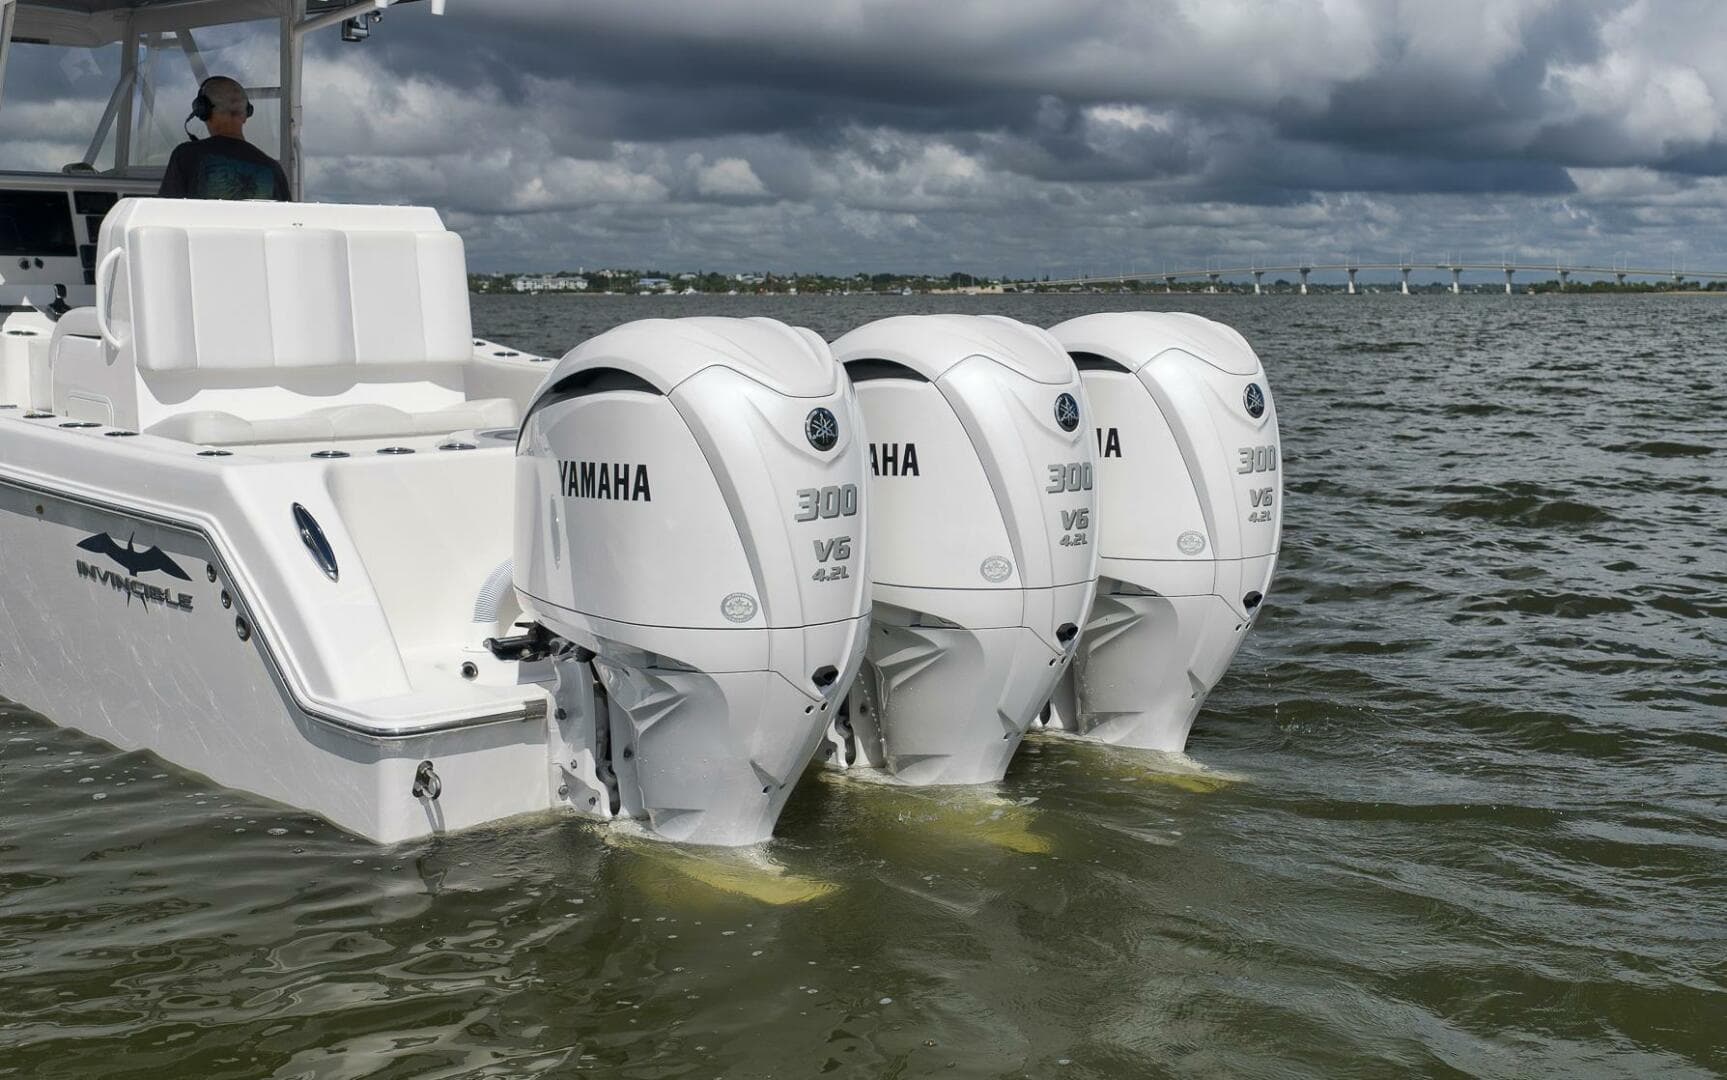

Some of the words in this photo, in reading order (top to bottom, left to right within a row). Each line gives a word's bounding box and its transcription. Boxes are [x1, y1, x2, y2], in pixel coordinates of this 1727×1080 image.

[1237, 446, 1276, 475] 300
[558, 460, 651, 502] YAMAHA
[1046, 462, 1092, 493] 300
[794, 484, 857, 522] 300
[1249, 487, 1273, 508] V6
[1061, 508, 1089, 531] V6
[1248, 511, 1272, 523] 4.2L
[813, 536, 851, 562] V6
[1060, 533, 1088, 547] 4.2L
[76, 559, 194, 613] INVINCIBLE
[811, 565, 850, 582] 4.2L
